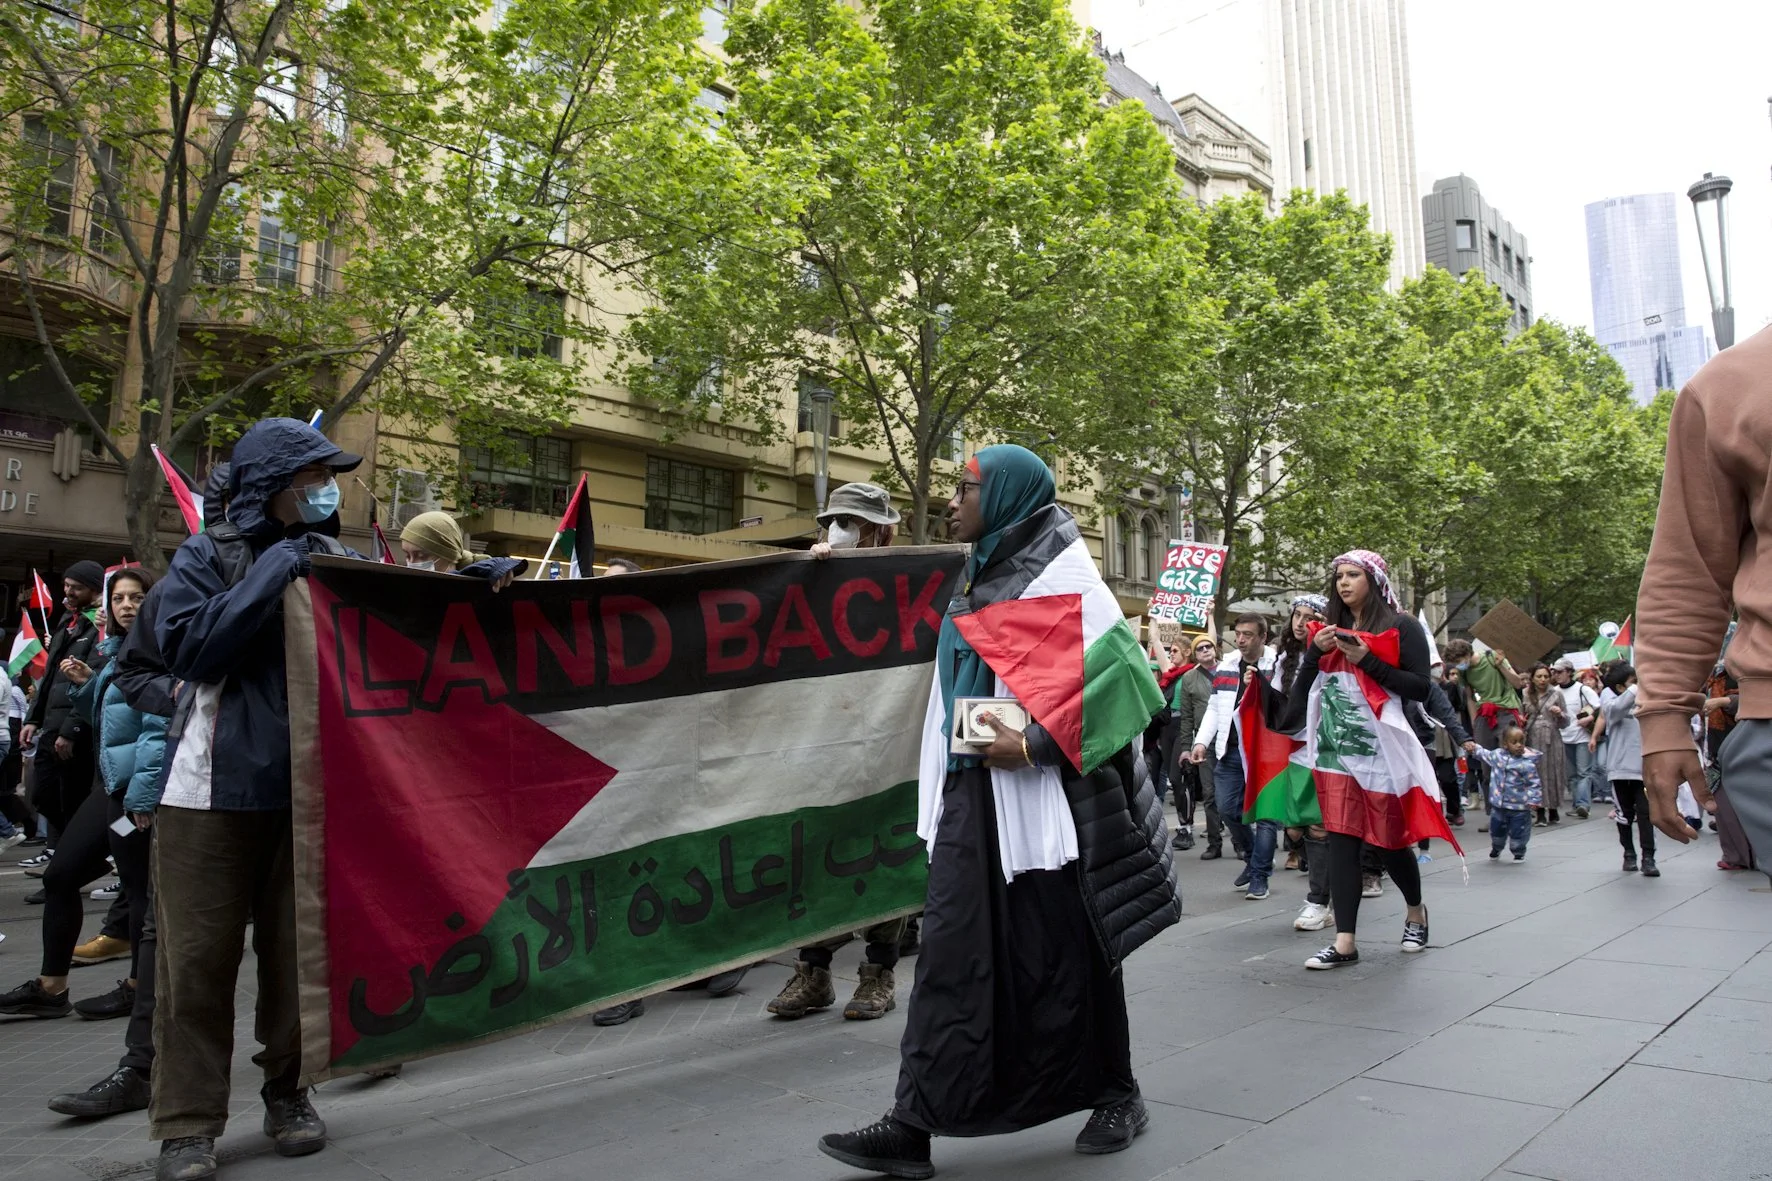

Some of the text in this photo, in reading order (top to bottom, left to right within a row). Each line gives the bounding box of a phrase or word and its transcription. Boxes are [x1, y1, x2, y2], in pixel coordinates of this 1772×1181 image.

[333, 570, 946, 715] LAND BACK
[1151, 604, 1203, 624] SIEGE!
[1155, 592, 1208, 609] END THE
[628, 820, 806, 937] إعادة
[350, 868, 597, 1036] الأرض
